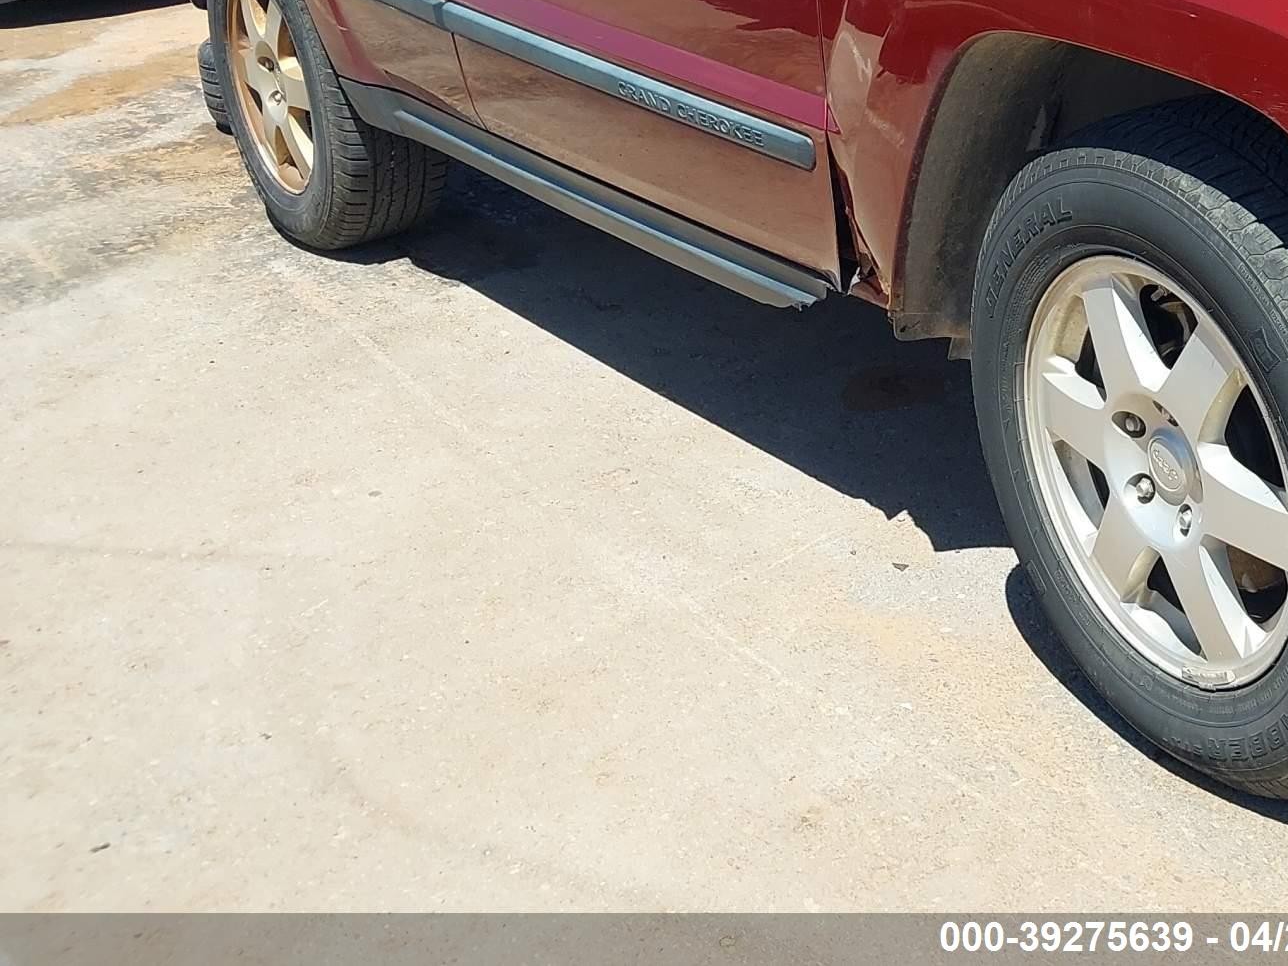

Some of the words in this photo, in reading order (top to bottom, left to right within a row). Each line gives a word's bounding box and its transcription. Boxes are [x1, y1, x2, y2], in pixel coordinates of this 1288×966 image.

[617, 80, 671, 115] GRAND
[677, 103, 765, 148] CHEROKEE
[985, 194, 1073, 319] GENERAL
